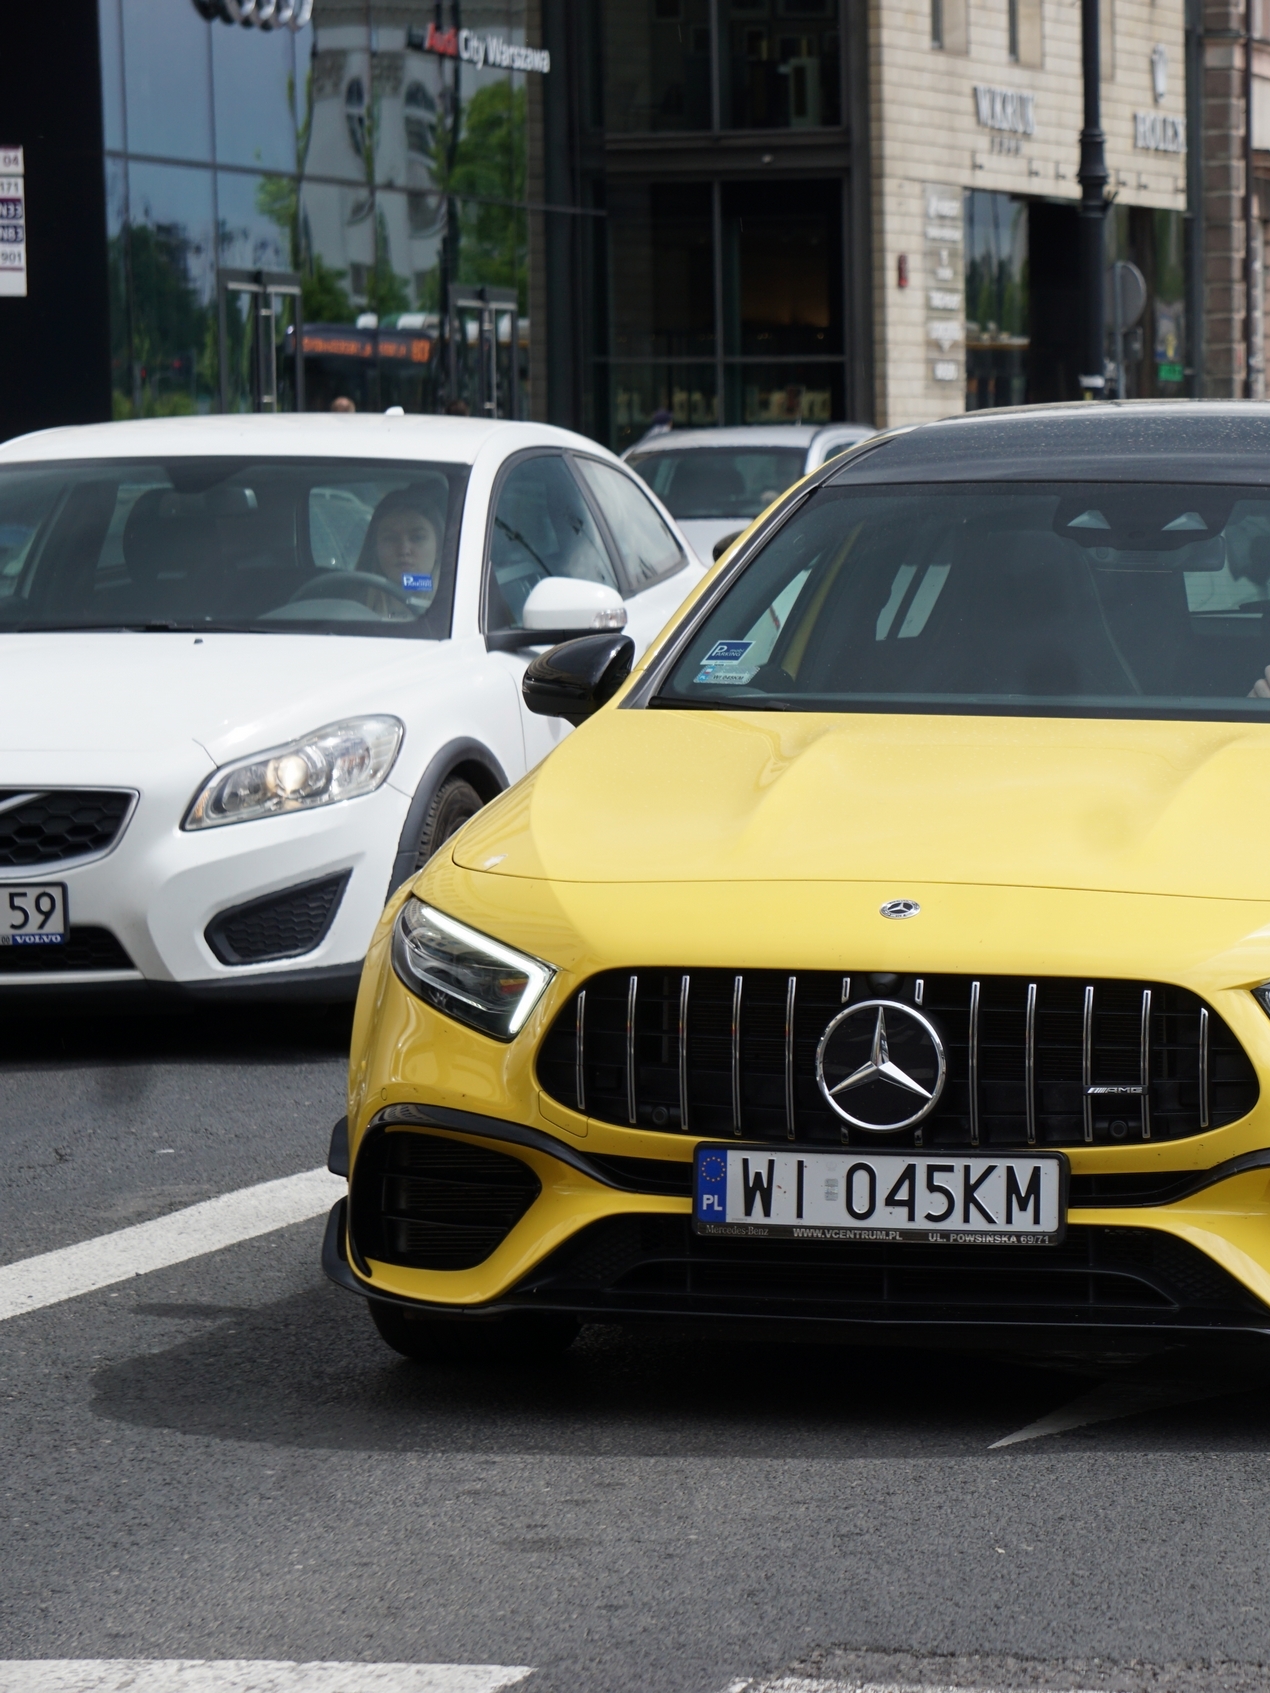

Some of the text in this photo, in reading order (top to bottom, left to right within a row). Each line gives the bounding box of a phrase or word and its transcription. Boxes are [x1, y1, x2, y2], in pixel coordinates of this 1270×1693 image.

[425, 22, 550, 73] Audi City Warszawa
[1134, 111, 1188, 153] ROLEX
[8, 890, 57, 930] 59
[15, 934, 61, 943] VOLVO
[845, 1160, 1042, 1225] 045KM
[703, 1194, 723, 1211] PL
[705, 1224, 769, 1236] Mercedes-Benz
[793, 1227, 903, 1241] WWW.VCENTRUM.PL
[928, 1232, 1050, 1244] UL. POWSIŃSKA 69/71
